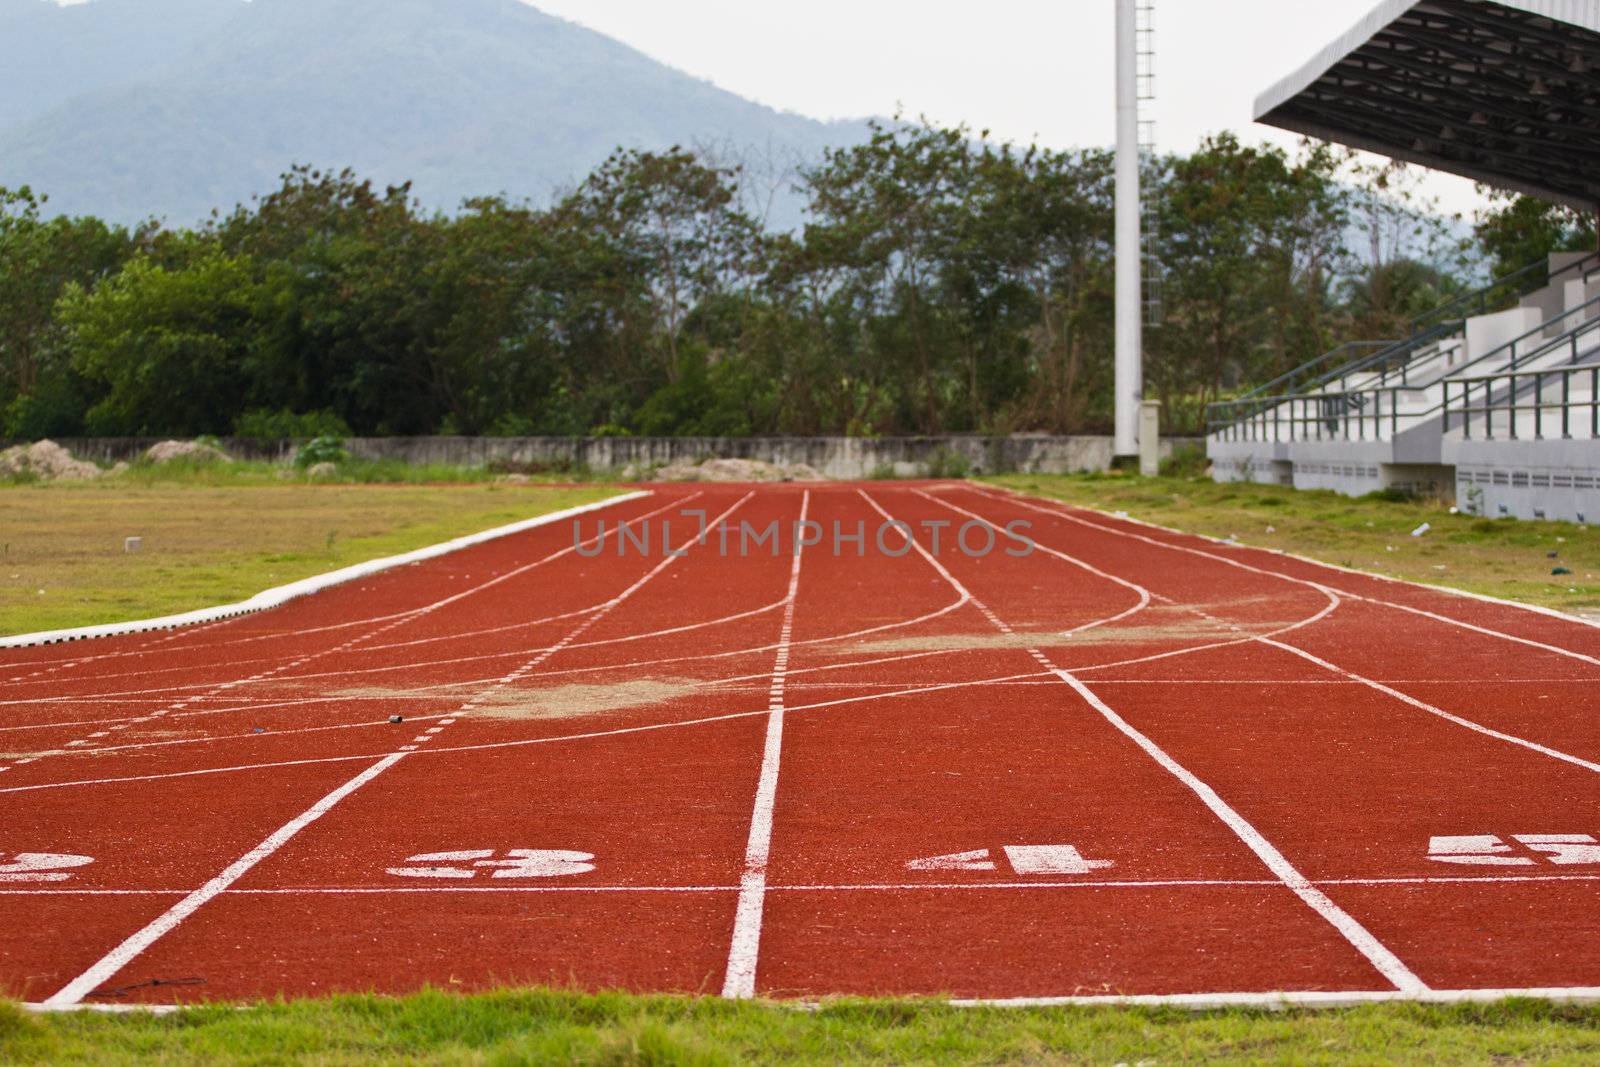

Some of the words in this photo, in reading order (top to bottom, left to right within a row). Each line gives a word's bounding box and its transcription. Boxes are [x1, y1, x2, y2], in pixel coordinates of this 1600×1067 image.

[385, 849, 596, 879] 3
[906, 845, 1114, 875] 4
[1426, 834, 1600, 867] 5
